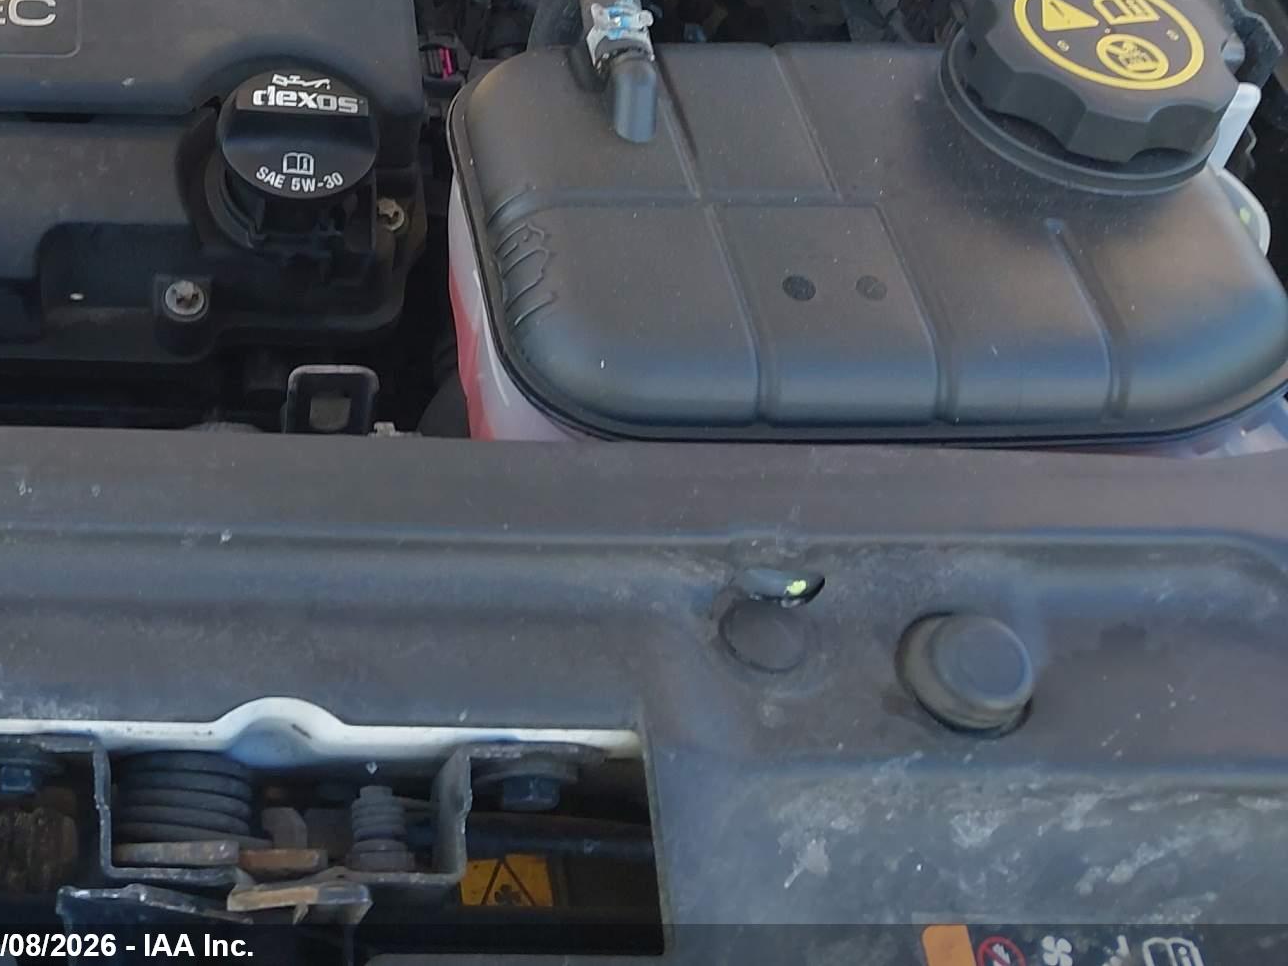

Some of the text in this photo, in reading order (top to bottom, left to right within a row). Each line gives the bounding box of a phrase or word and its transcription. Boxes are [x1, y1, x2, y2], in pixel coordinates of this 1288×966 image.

[252, 85, 359, 114] dexos
[255, 165, 344, 193] SAE 5W-30
